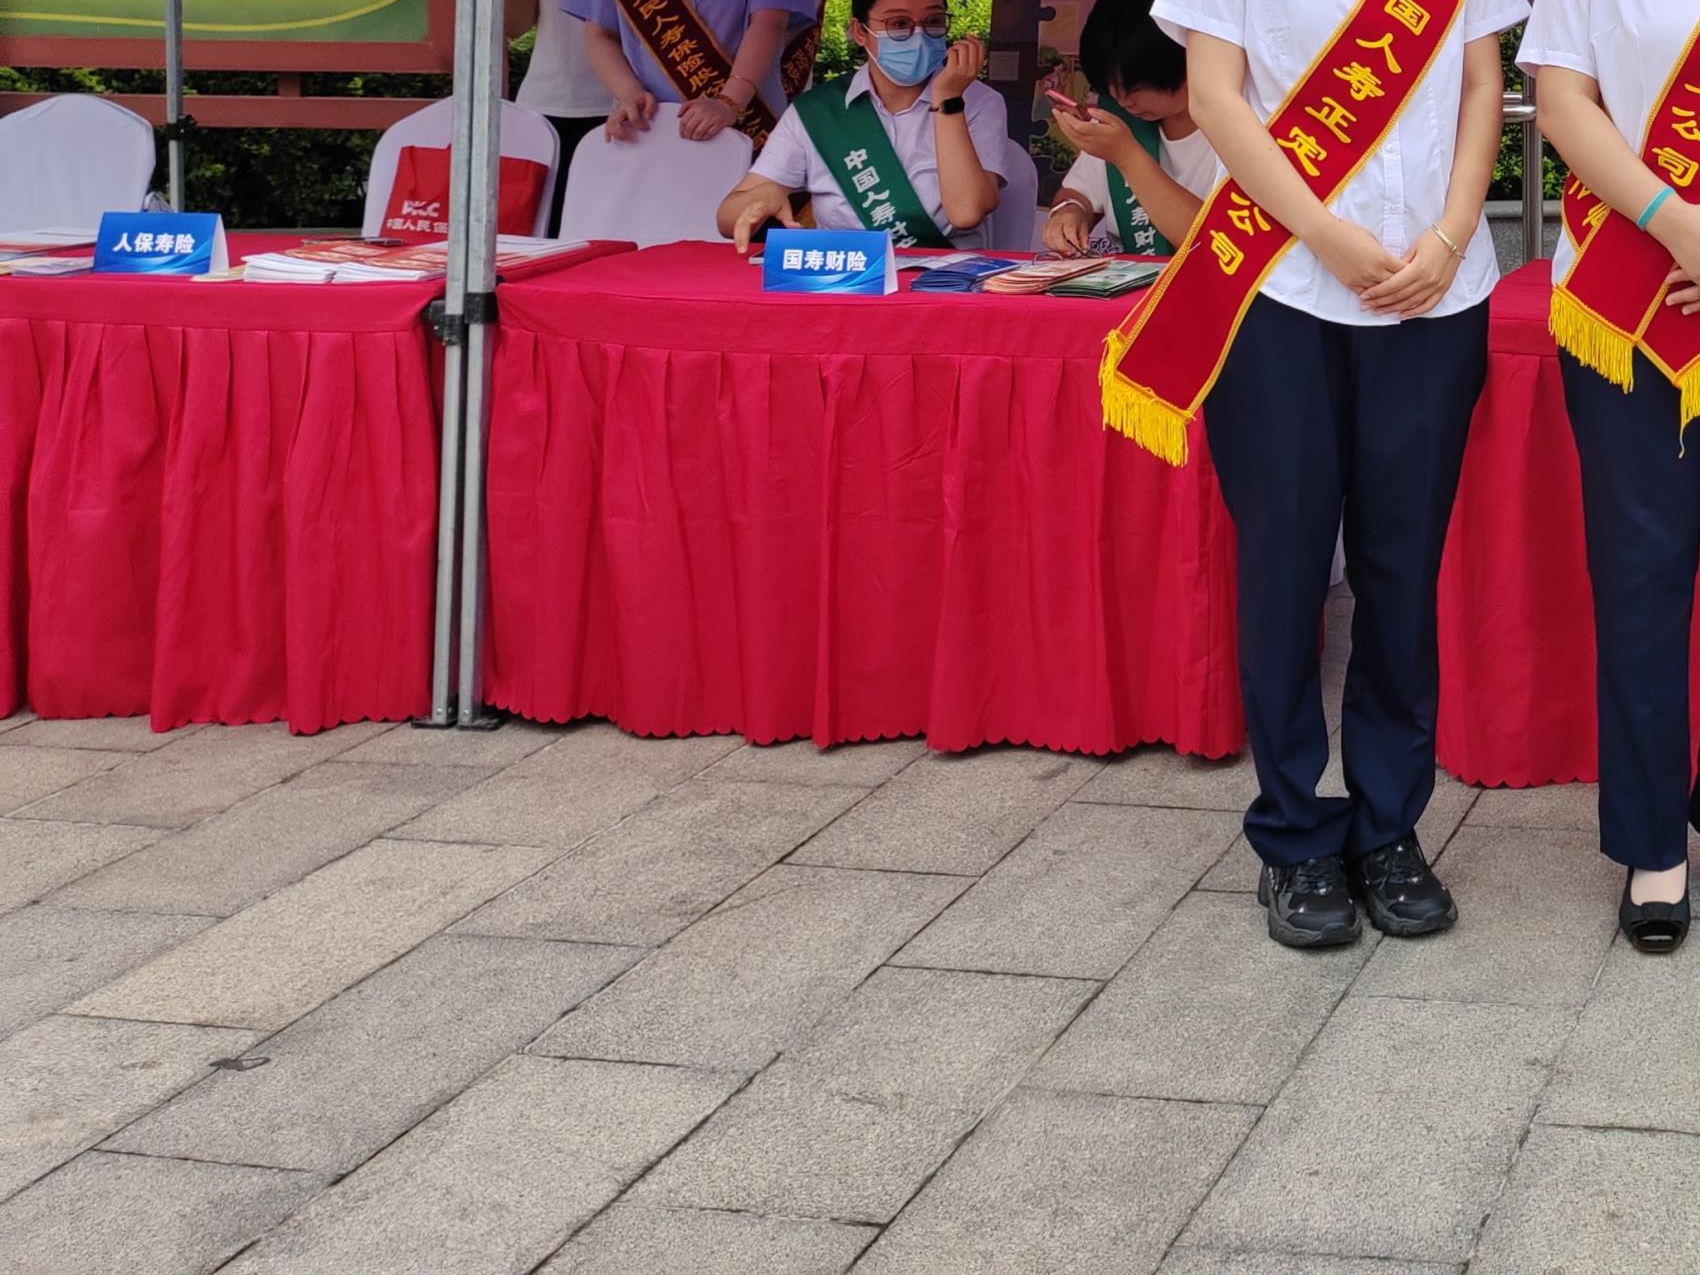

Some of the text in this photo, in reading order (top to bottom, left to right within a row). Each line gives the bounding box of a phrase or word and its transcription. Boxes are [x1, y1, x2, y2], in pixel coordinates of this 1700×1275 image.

[113, 232, 196, 254] 人保寿险
[782, 249, 867, 272] 国寿财险
